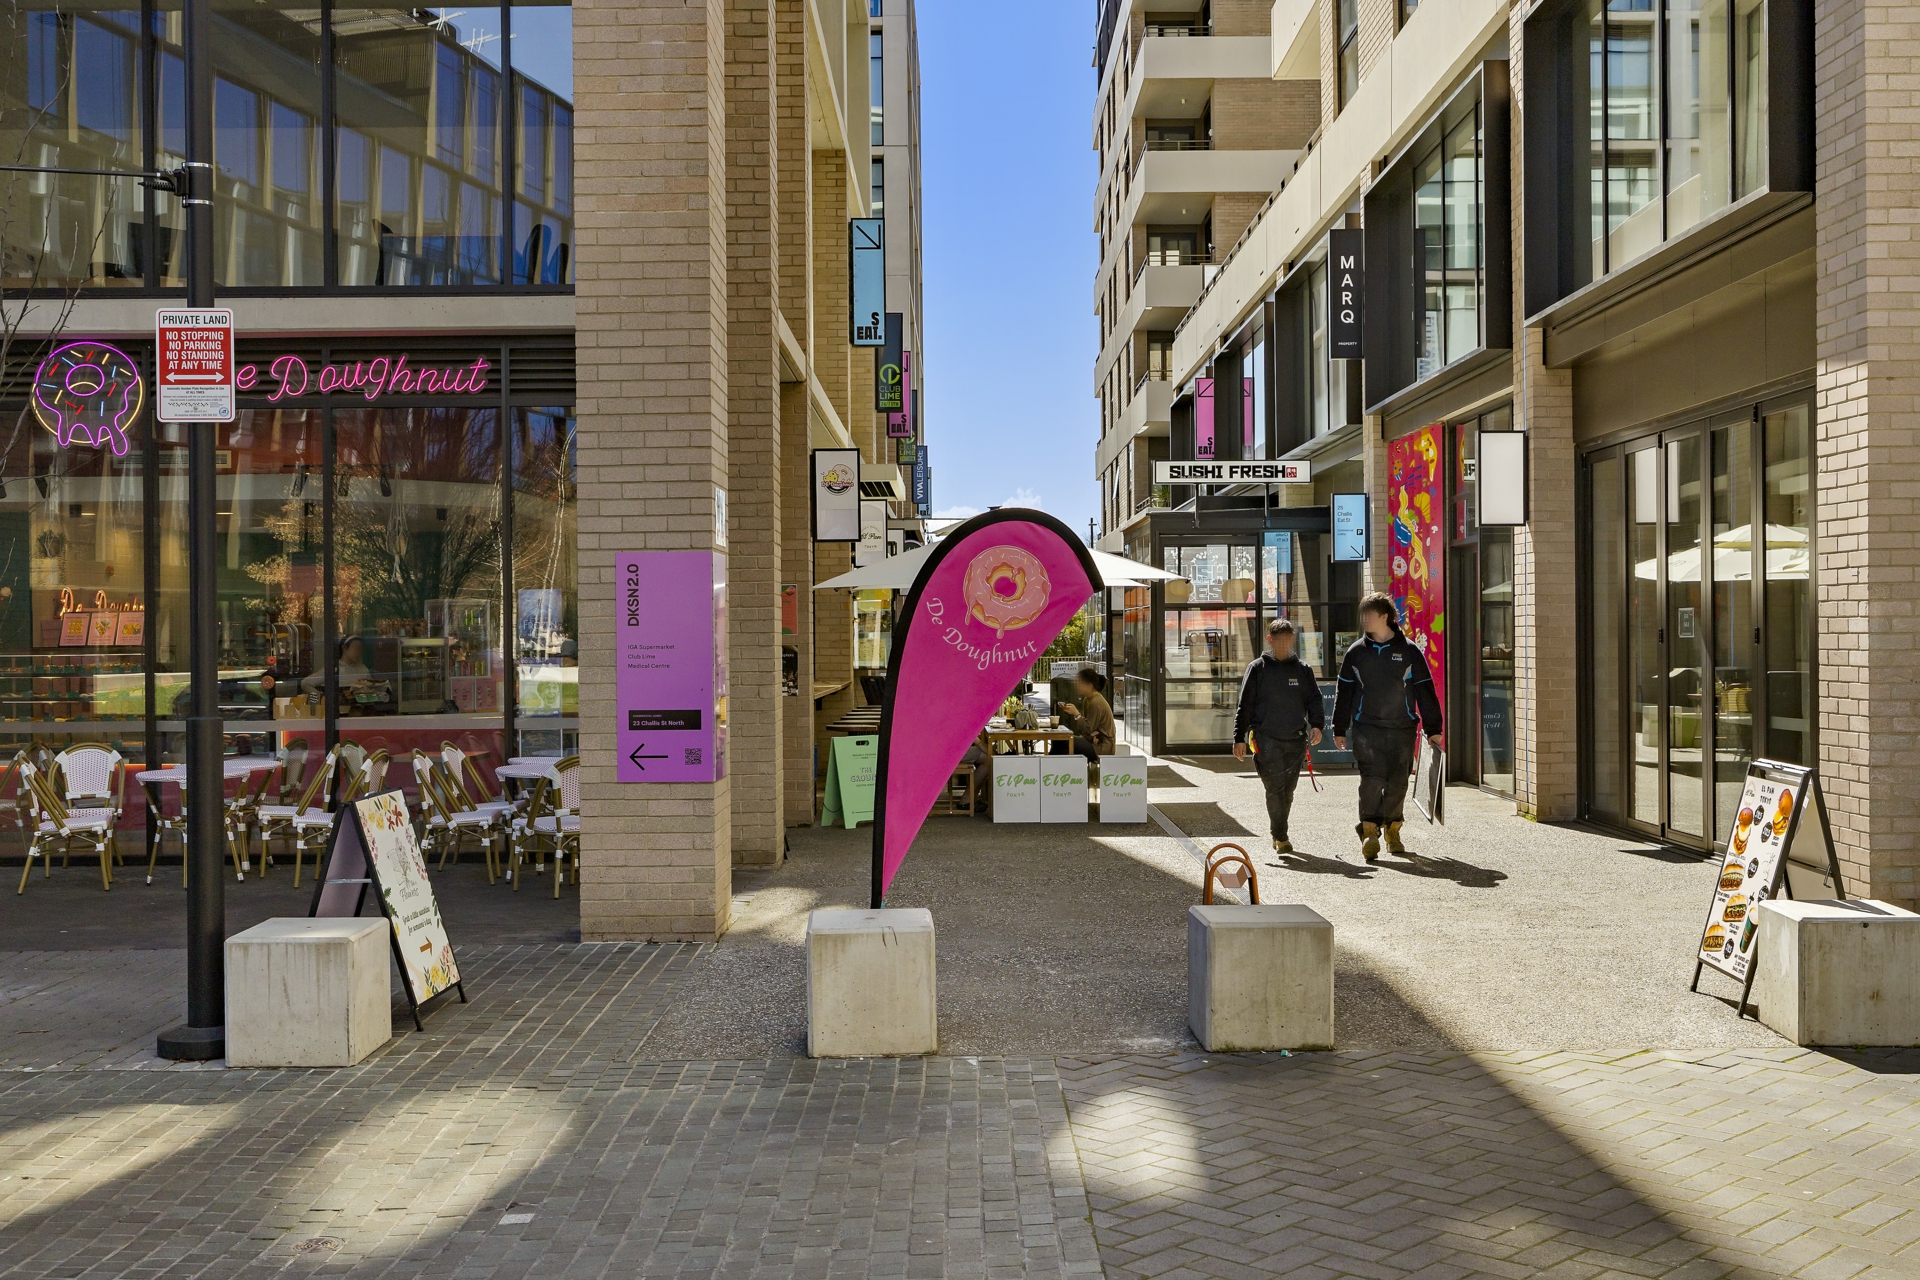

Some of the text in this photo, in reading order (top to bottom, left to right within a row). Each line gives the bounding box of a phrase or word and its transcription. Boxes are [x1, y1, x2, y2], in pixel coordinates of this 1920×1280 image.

[1340, 255, 1354, 324] MARQ
[162, 316, 227, 324] PRIVATE LAND
[166, 331, 224, 340] NO STOPPING
[857, 326, 882, 340] EAT.
[169, 341, 221, 350] NO PARKING
[166, 351, 224, 360] NO STANDING
[168, 361, 222, 369] AT ANY TIME
[236, 355, 488, 400] e Doughnut
[891, 424, 908, 433] EAT.
[1198, 446, 1214, 455] EAT.
[1169, 465, 1286, 478] SUSHI FRESH
[926, 597, 1037, 670] De Doughnut
[1760, 795, 1772, 805] TOKYO
